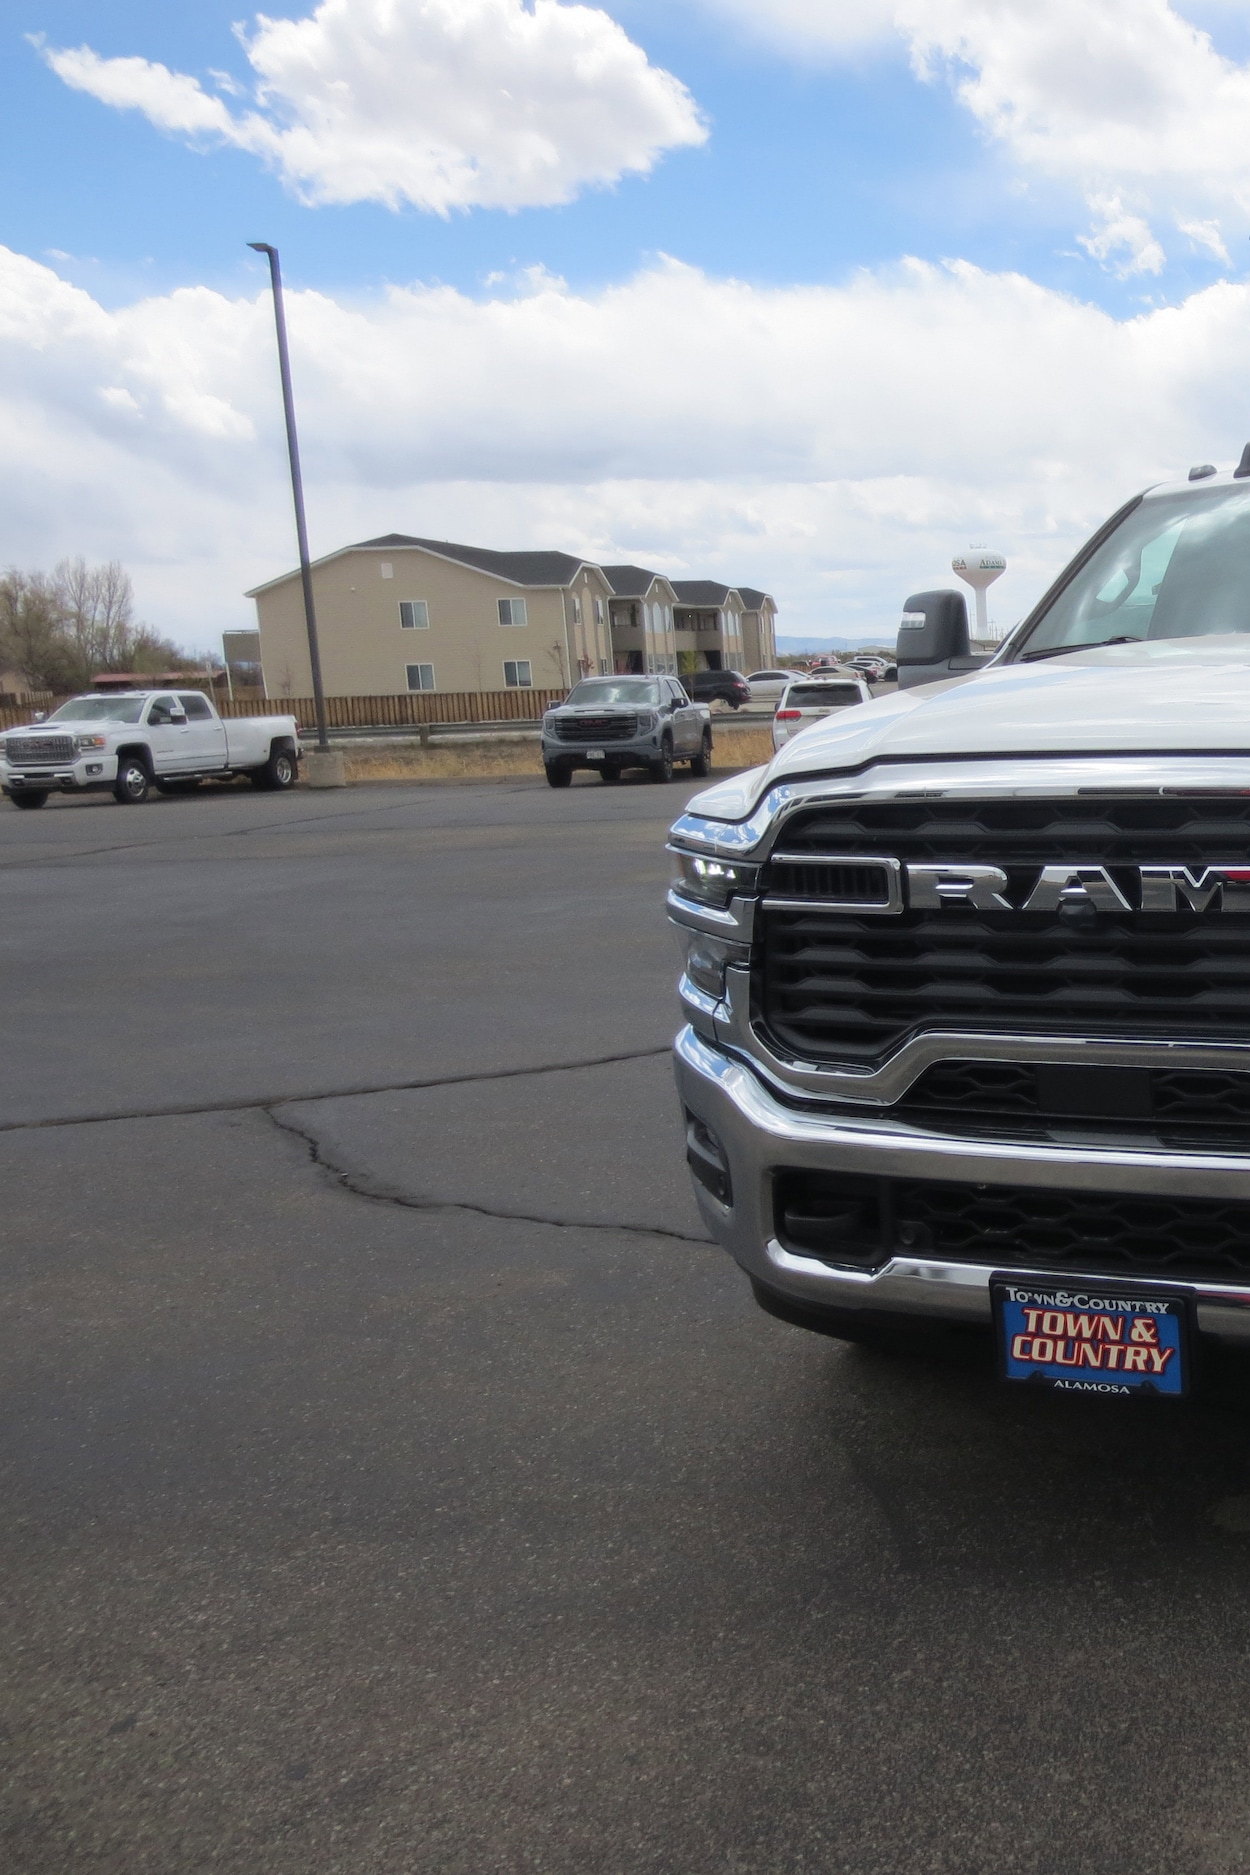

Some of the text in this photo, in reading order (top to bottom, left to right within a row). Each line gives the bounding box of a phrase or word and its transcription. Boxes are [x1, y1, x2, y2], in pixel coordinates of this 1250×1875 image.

[1022, 1307, 1159, 1344] TOWN &
[1012, 1334, 1174, 1374] COUNTRY
[1053, 1379, 1131, 1394] ALAMOSA
